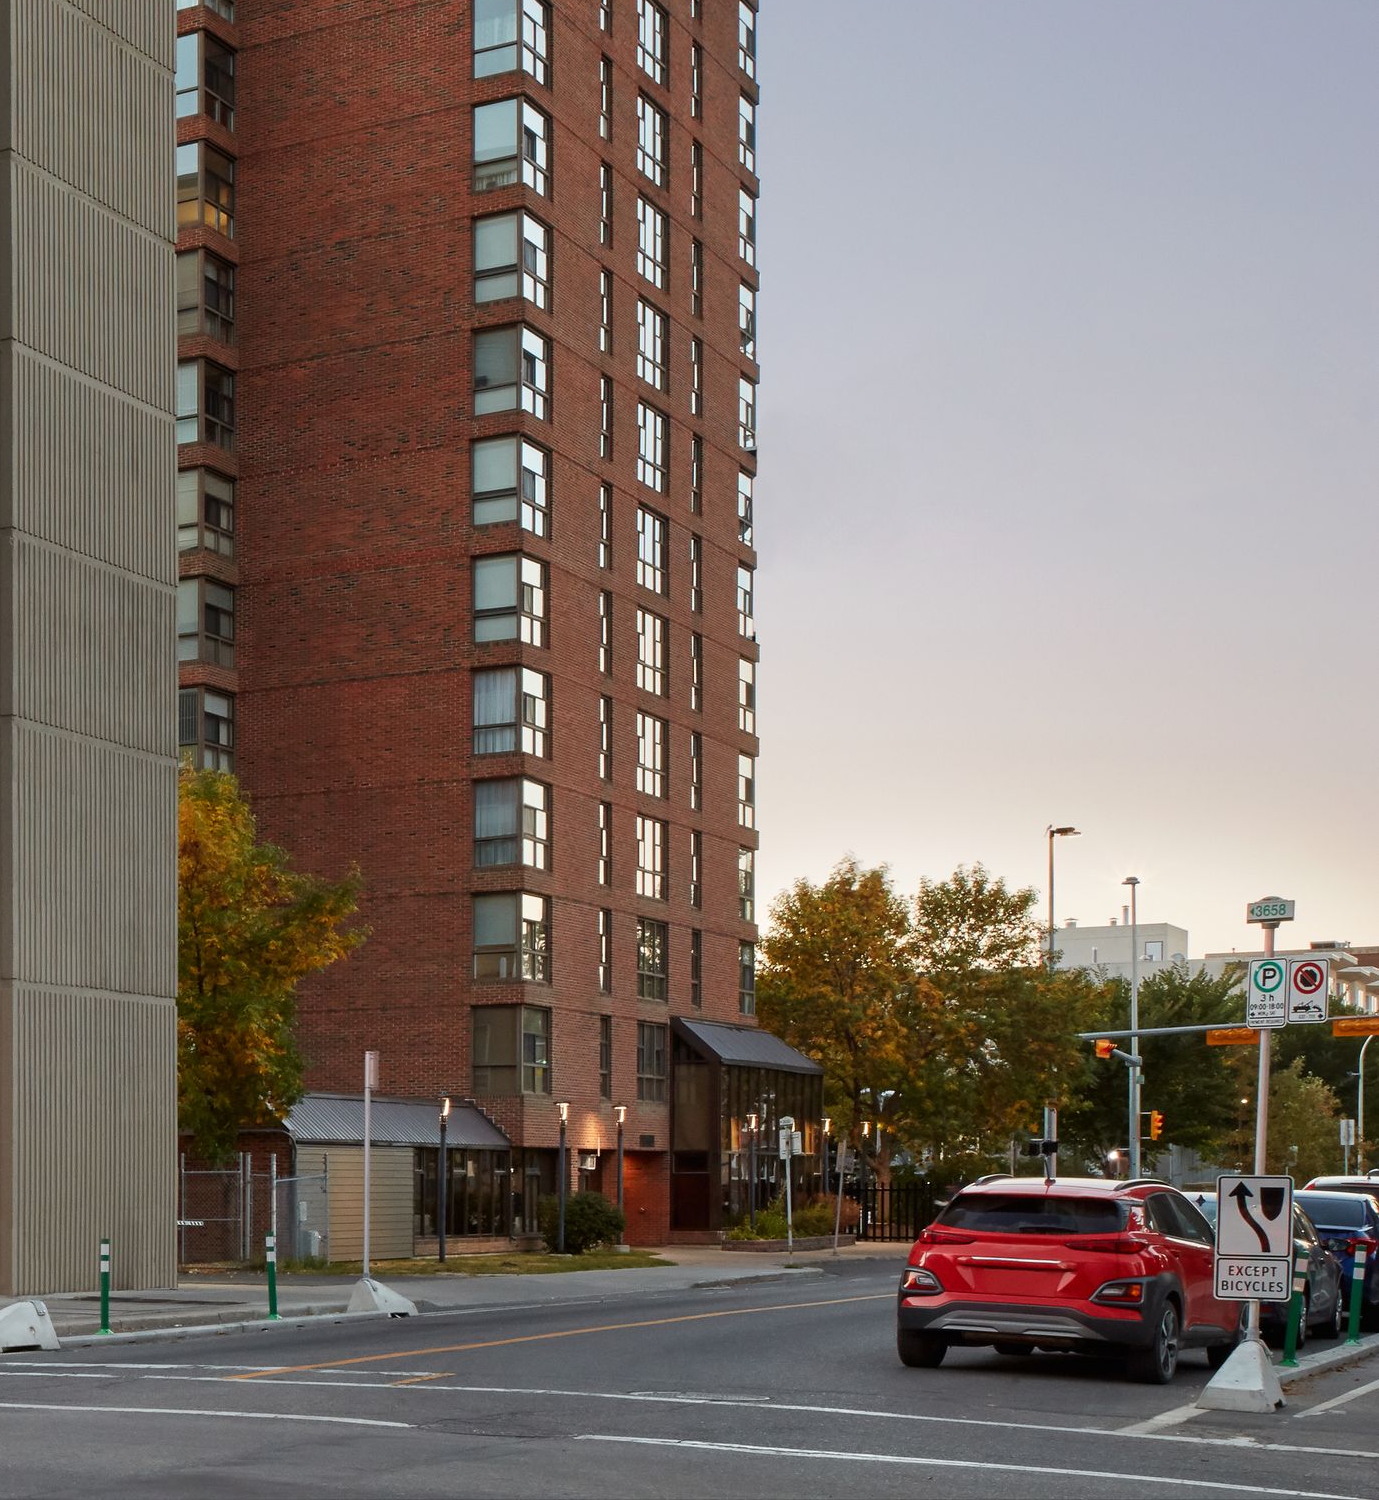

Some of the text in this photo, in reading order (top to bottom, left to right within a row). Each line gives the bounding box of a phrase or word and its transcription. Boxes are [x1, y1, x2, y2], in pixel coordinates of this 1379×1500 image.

[1255, 903, 1287, 918] 3658
[1260, 994, 1267, 1002] 3
[1228, 1265, 1278, 1277] EXCEPT
[1221, 1280, 1284, 1293] BICYCLES
